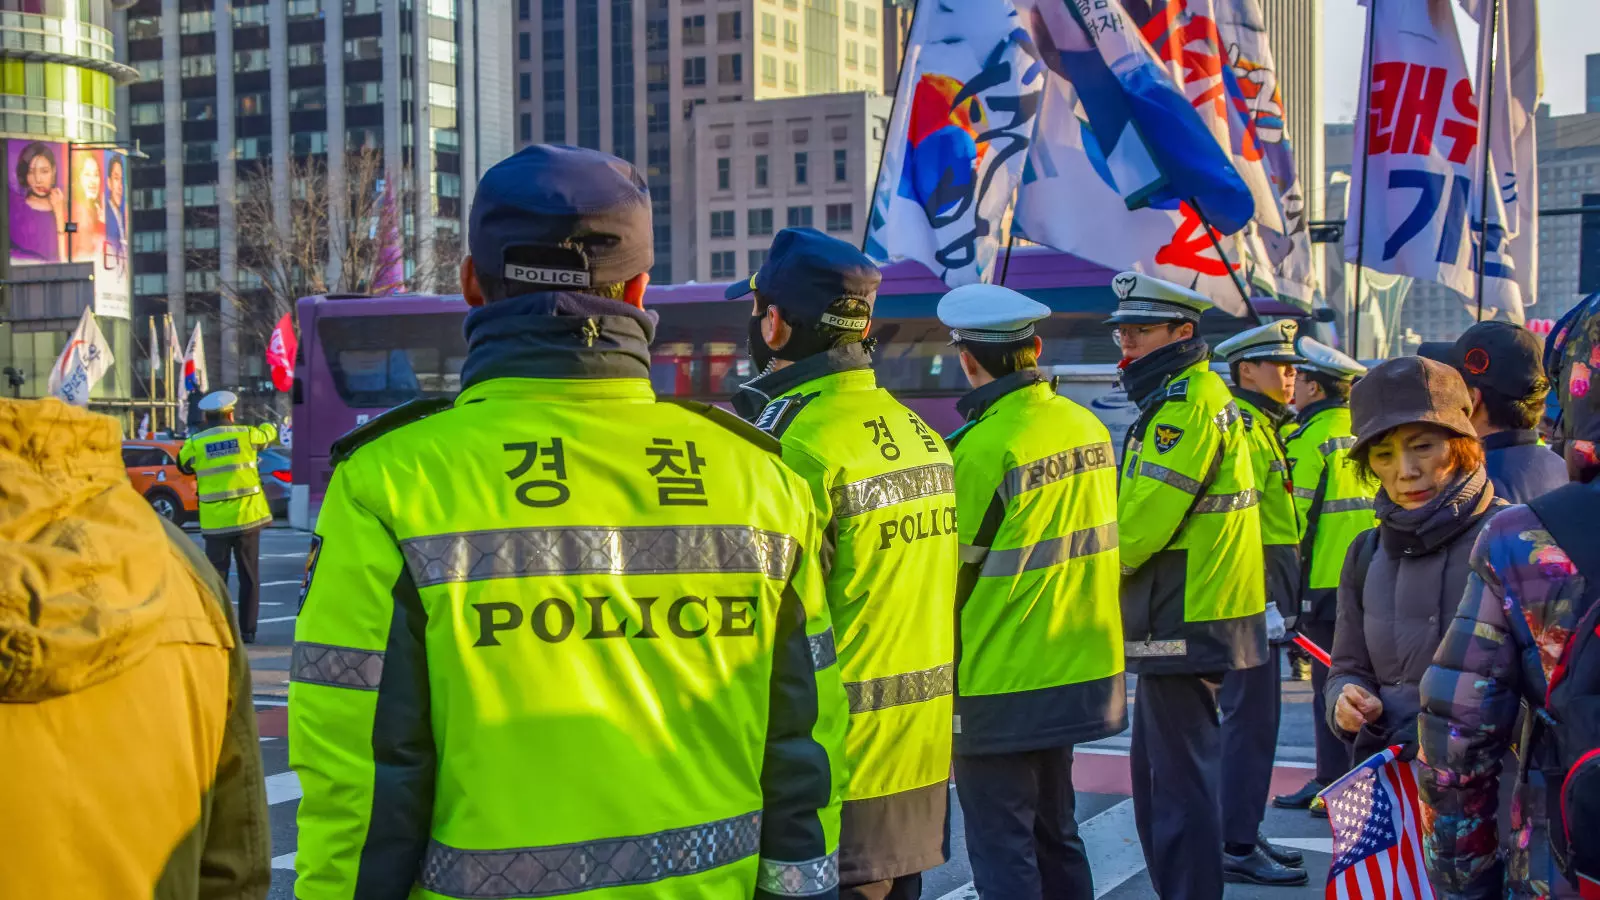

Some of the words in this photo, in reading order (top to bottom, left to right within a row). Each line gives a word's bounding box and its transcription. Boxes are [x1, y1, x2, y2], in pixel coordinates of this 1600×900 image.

[504, 267, 584, 284] POLICE
[829, 316, 865, 328] POLICE
[1026, 447, 1107, 485] POLICE
[471, 596, 759, 648] POLICE
